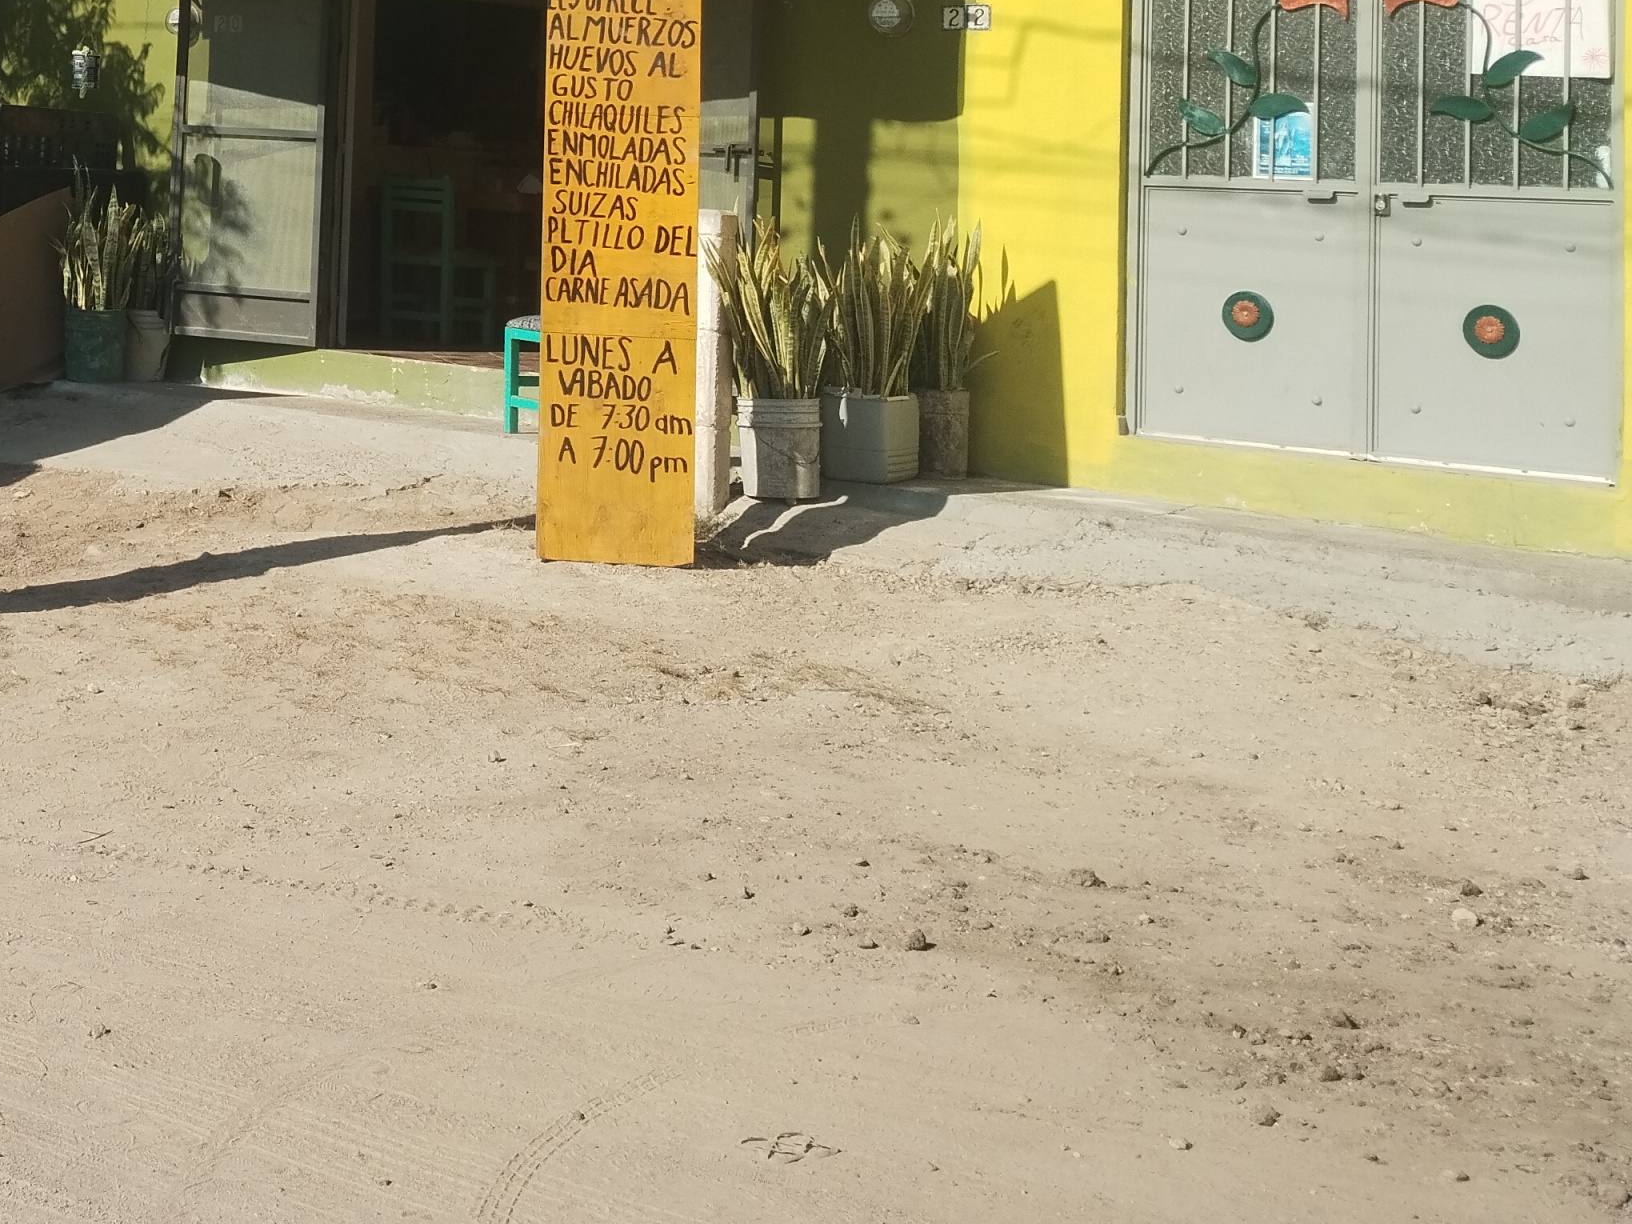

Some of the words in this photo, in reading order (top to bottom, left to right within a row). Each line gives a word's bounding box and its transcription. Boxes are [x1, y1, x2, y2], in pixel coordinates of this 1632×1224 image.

[548, 13, 698, 49] ALMUERZOS
[945, 6, 987, 29] 22
[549, 43, 639, 77] HUEVOS
[647, 51, 682, 78] AL
[552, 73, 634, 102] GUSTO
[548, 99, 686, 135] CHILAQUILES
[547, 128, 687, 165] ENMOLADAS
[551, 189, 639, 221] SUIZAS
[654, 224, 698, 257] DEL
[550, 245, 597, 277] DIA
[545, 276, 611, 306] CARNE
[613, 276, 690, 316] ASADA
[546, 334, 633, 372] LUNES
[651, 340, 678, 375] A
[551, 403, 580, 428] DE
[601, 403, 651, 432] 7:30
[558, 436, 577, 465] A
[591, 435, 645, 475] 7:00
[650, 456, 688, 483] pm
